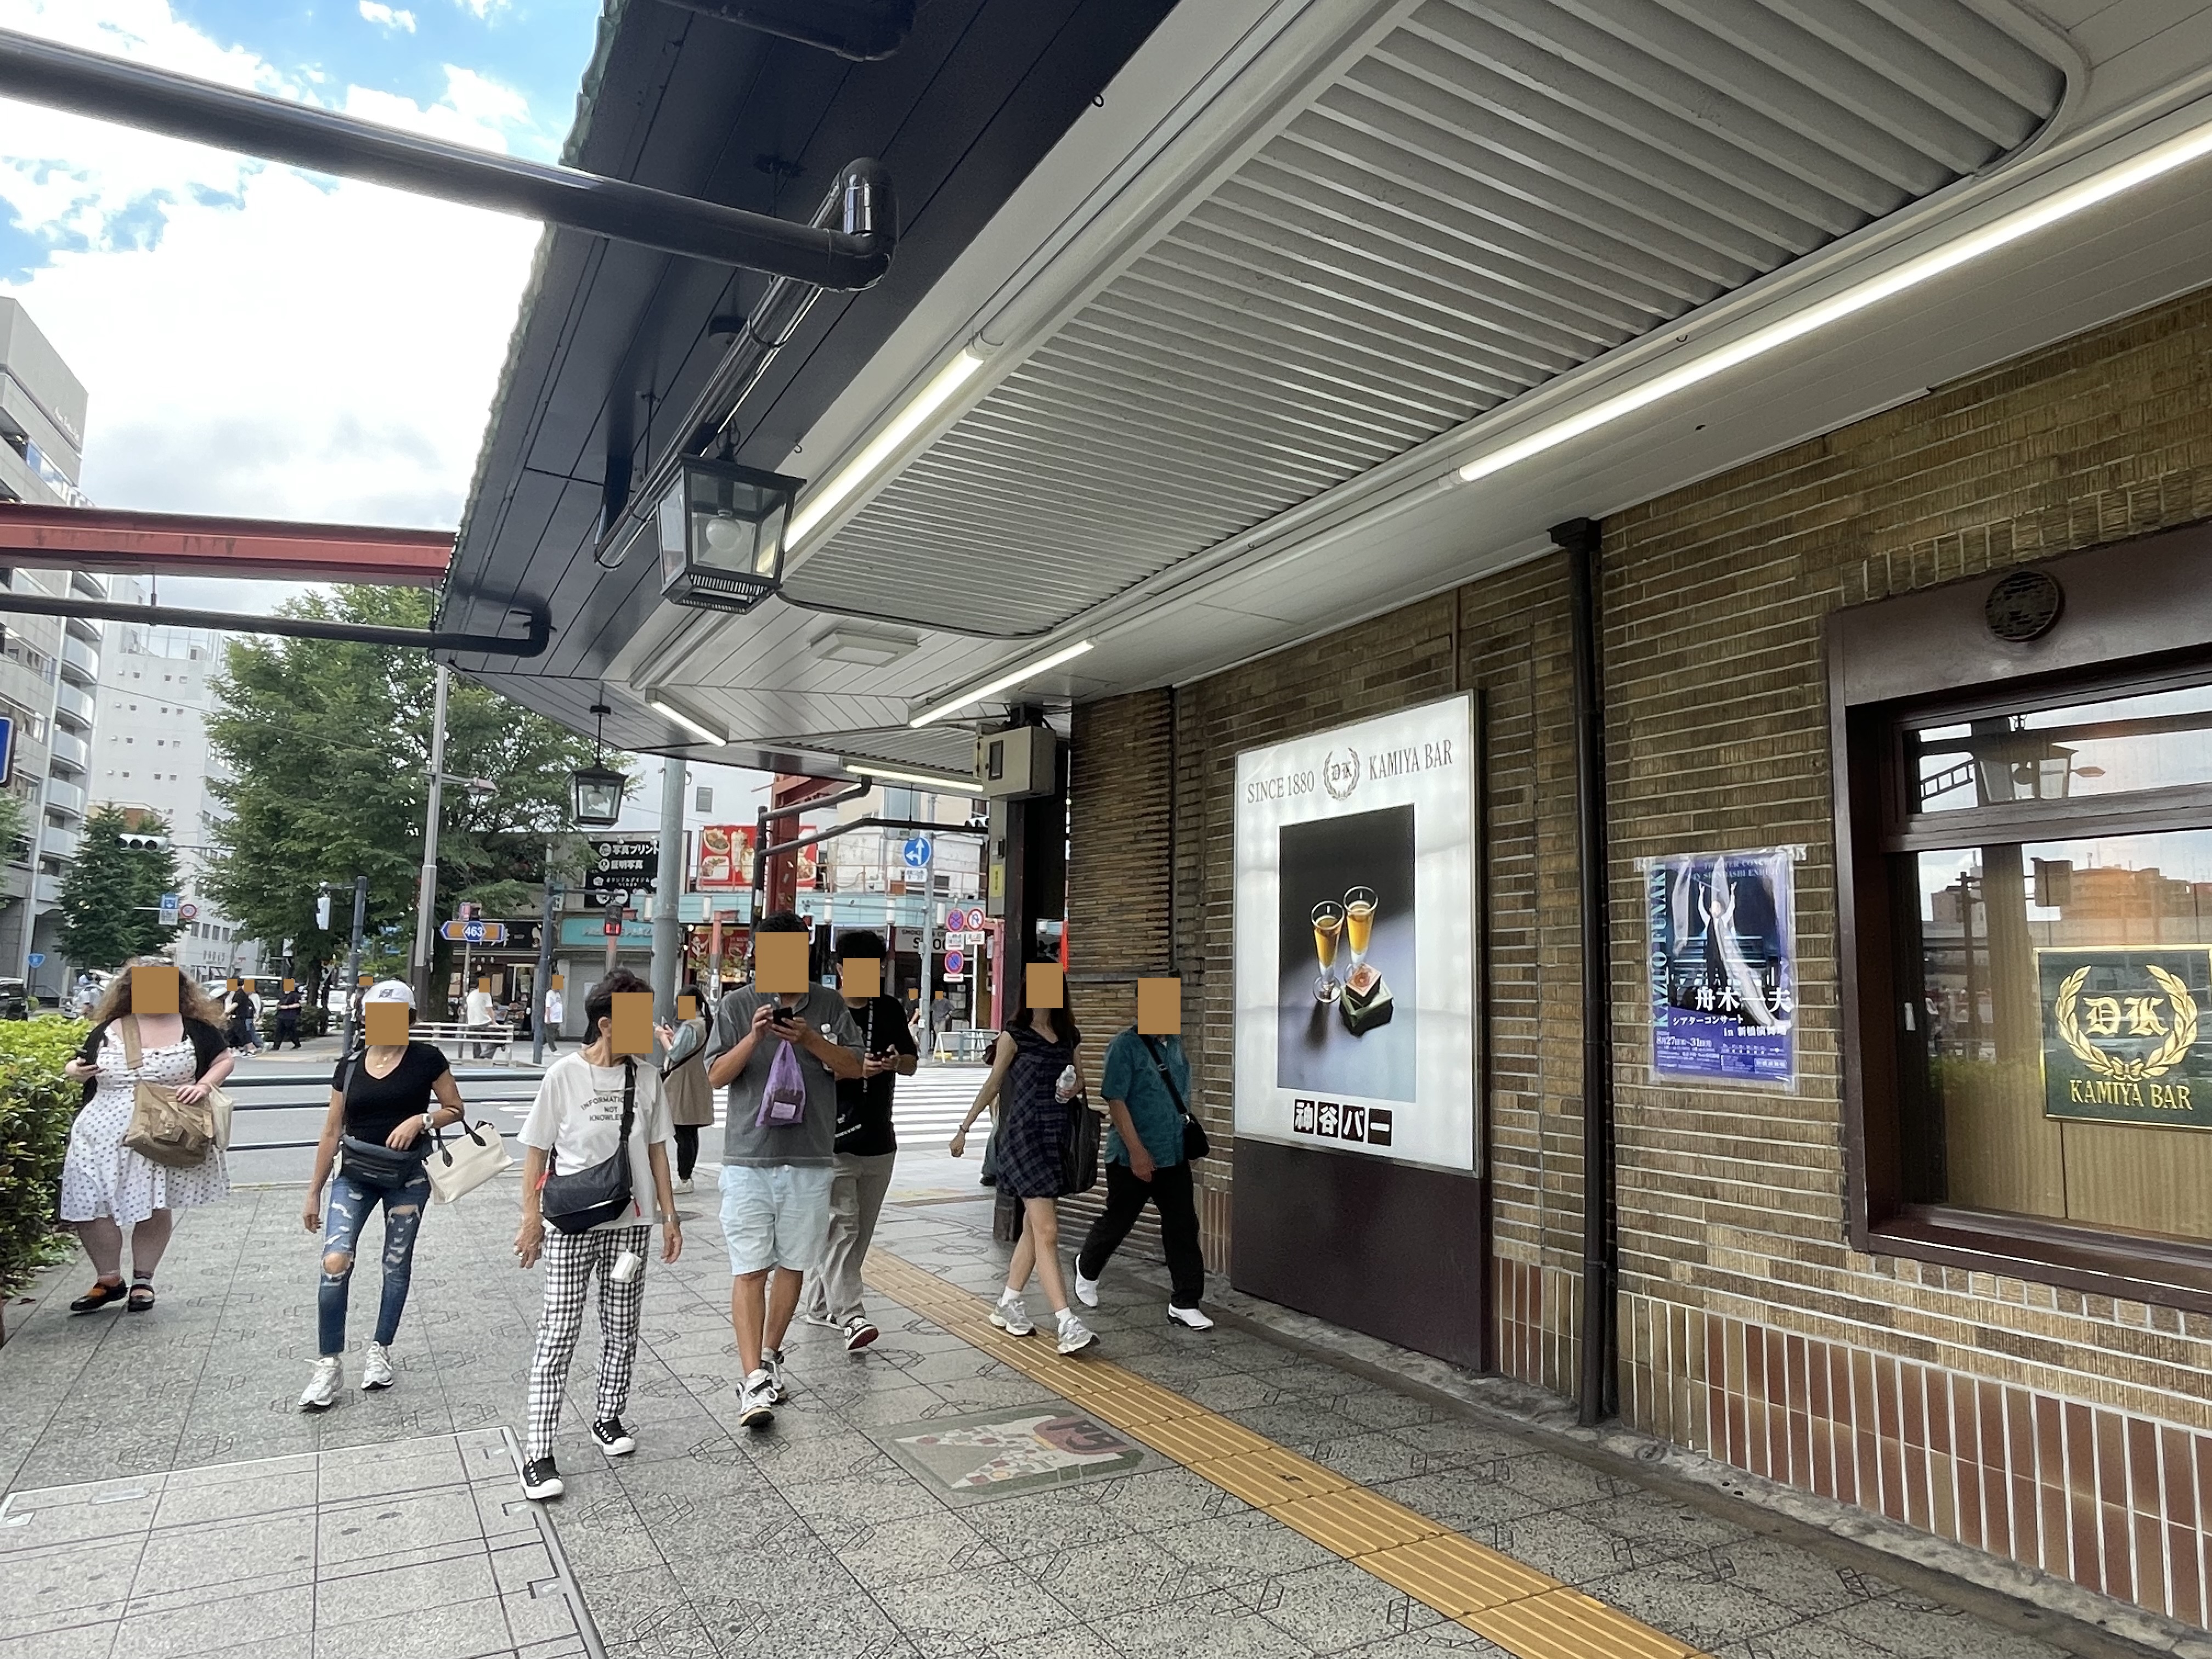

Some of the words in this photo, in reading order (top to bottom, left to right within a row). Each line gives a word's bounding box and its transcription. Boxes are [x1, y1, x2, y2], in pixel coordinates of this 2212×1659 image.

[1248, 777, 1285, 803] SINCE
[1287, 770, 1314, 797] 1880
[1369, 746, 1420, 780] KAMIYA
[1424, 739, 1453, 769] BAR
[1650, 864, 1667, 944] FUNAKI
[465, 926, 483, 937] 463
[1651, 951, 1669, 1028] KAZUO
[1694, 986, 1791, 1013] 舟木一夫
[1672, 1014, 1743, 1026] シアターコンサート
[2083, 996, 2169, 1036] DK
[2069, 1079, 2145, 1108] KAMIYA
[2149, 1084, 2193, 1111] BAR
